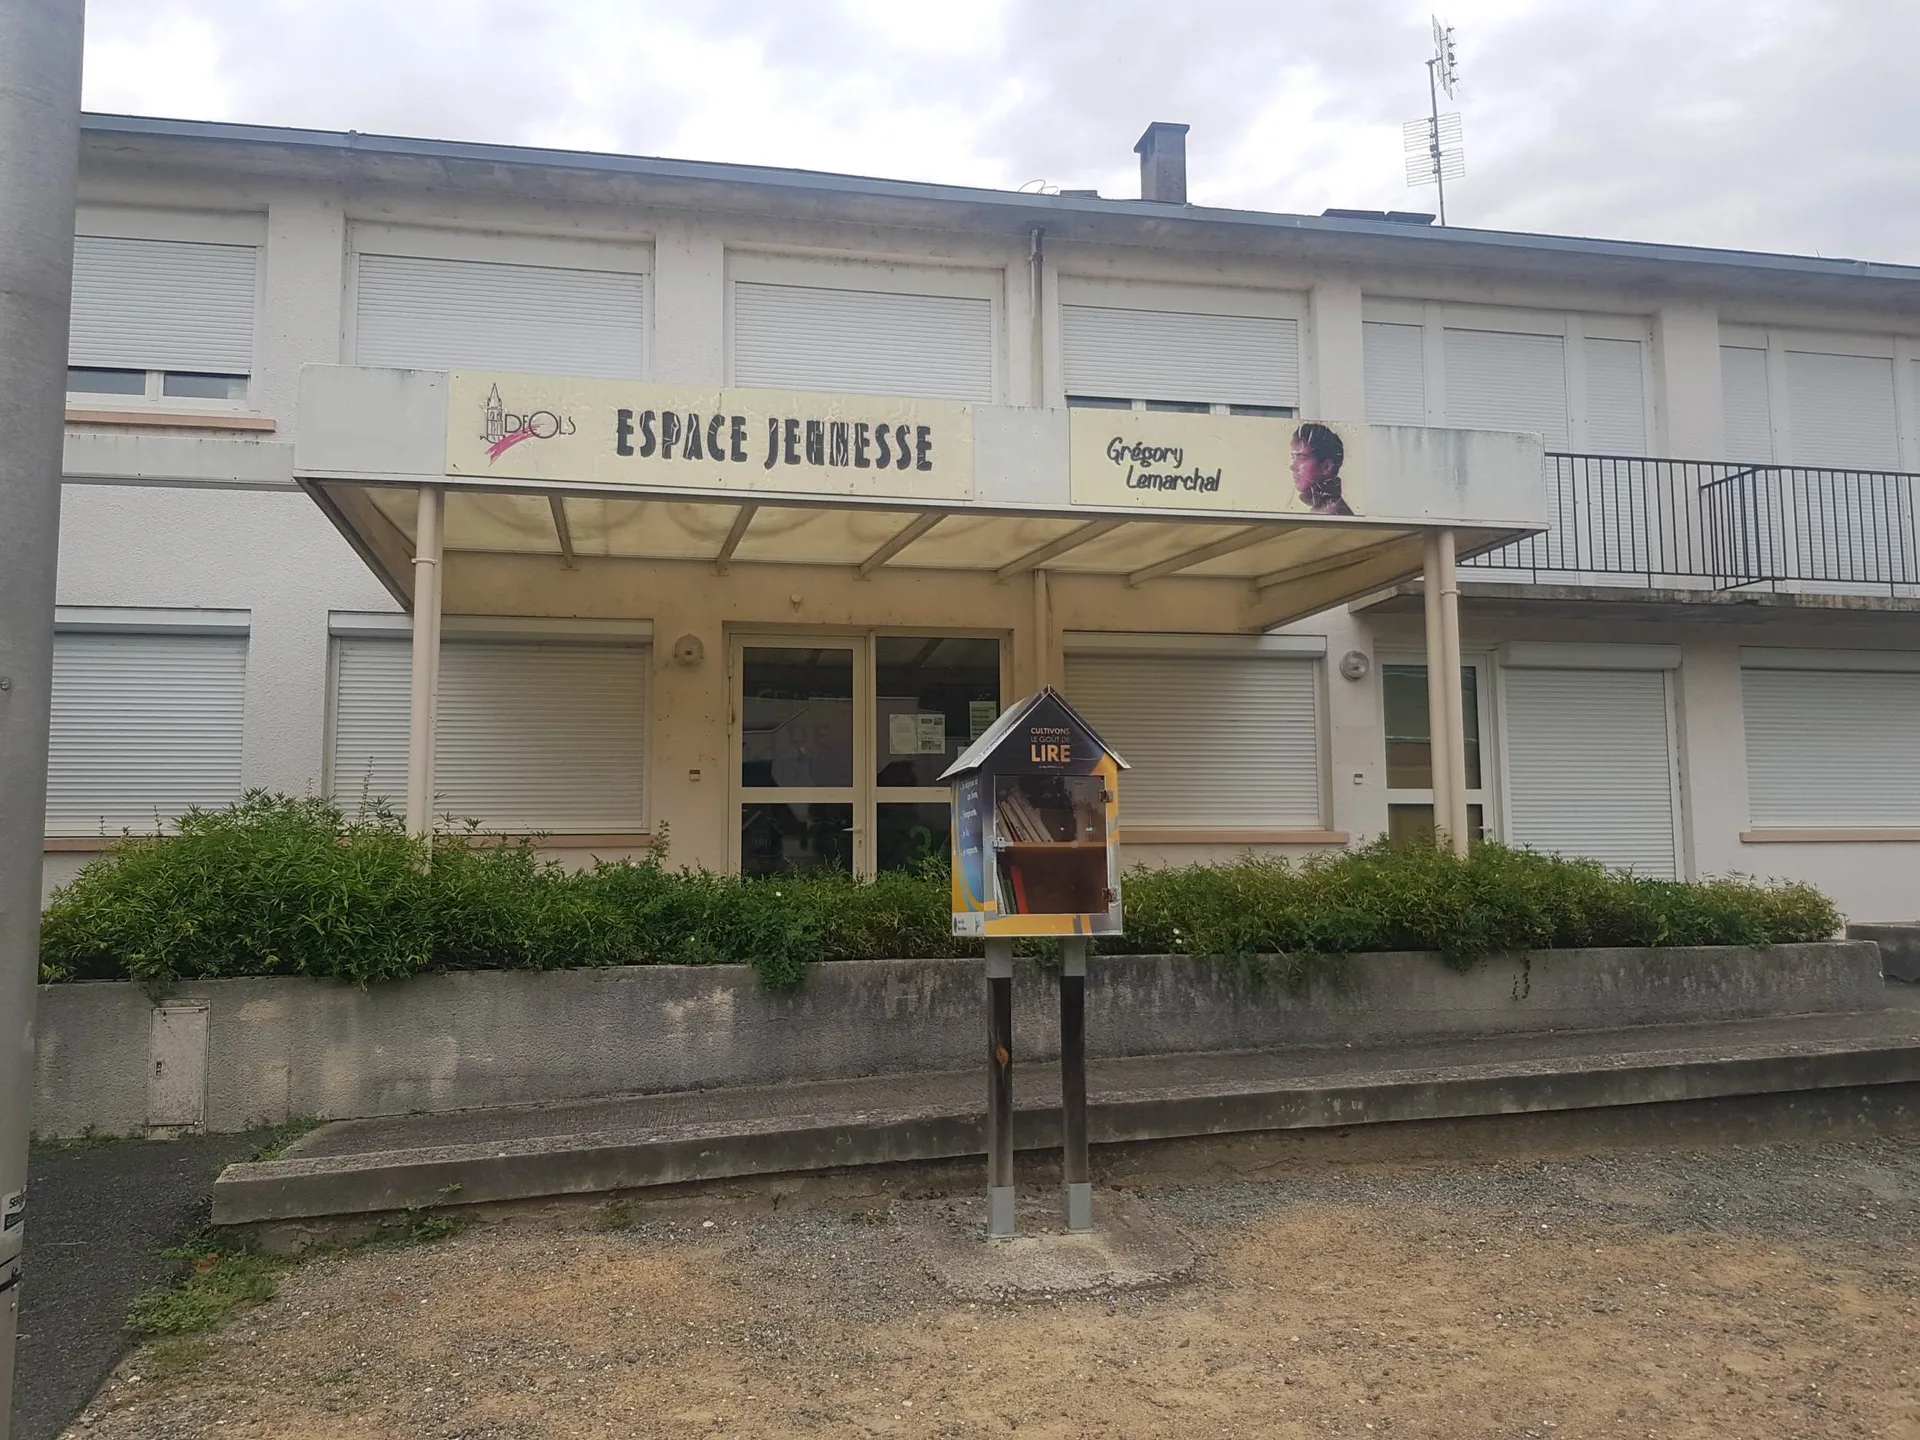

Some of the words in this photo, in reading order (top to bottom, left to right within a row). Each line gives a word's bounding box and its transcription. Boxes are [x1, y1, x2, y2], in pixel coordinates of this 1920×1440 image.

[616, 408, 749, 463] ESPACE
[763, 416, 933, 472] JEUNESSE
[1106, 436, 1184, 469] Grégory
[1125, 465, 1222, 492] Lemarchal
[1030, 726, 1071, 735] CULTIVONS
[1030, 735, 1039, 743] LE
[1061, 735, 1071, 743] DE
[1030, 744, 1071, 763] LIRE
